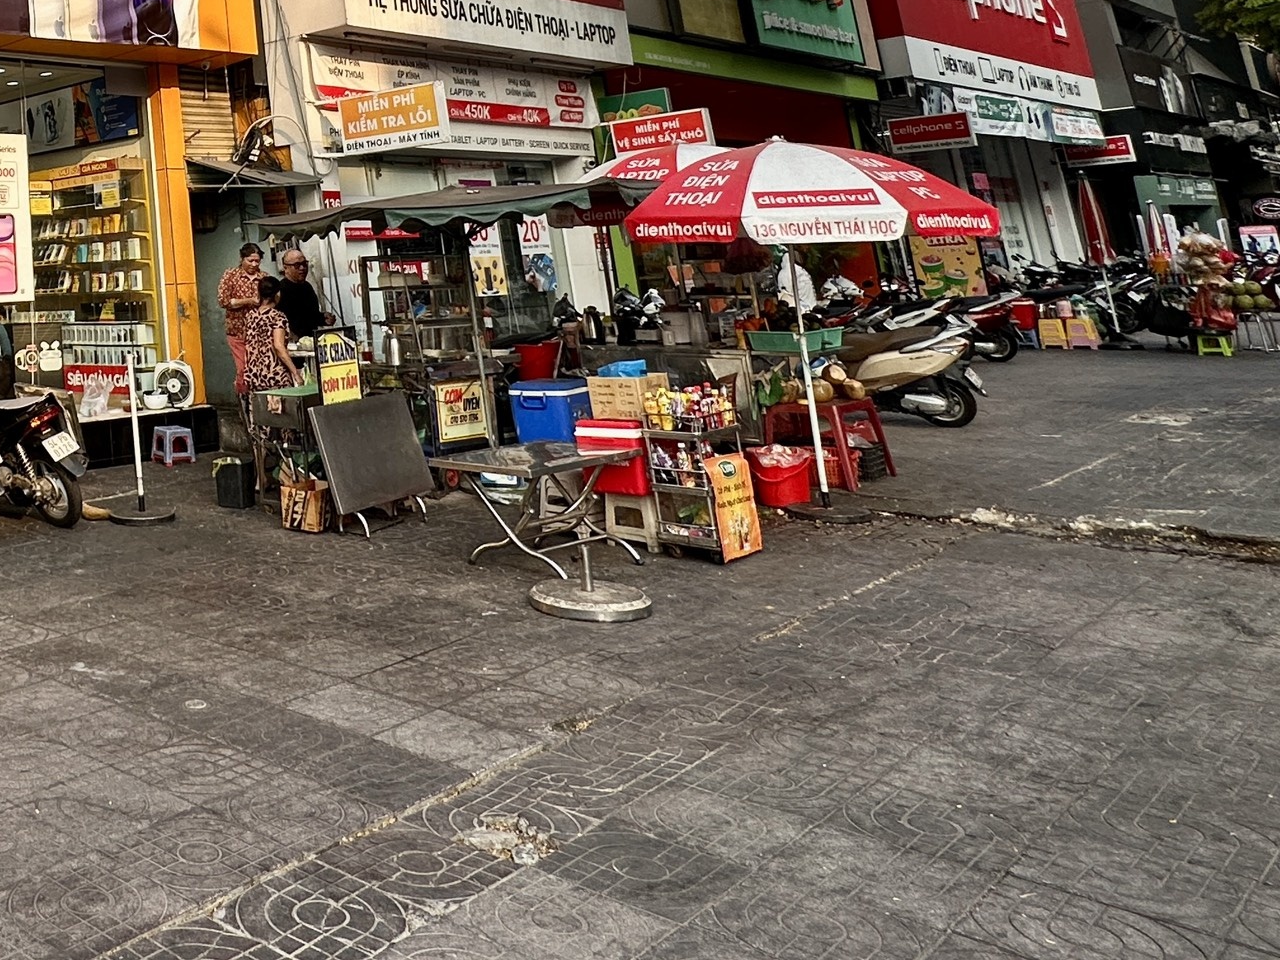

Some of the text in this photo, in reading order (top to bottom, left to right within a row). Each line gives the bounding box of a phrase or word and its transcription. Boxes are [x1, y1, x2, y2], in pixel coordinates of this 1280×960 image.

[469, 0, 504, 27] CHỮA
[506, 7, 534, 35] ĐIỆN
[535, 14, 570, 42] THOẠI
[575, 21, 616, 45] LAPTOP
[763, 11, 789, 29] juice
[799, 20, 838, 39] smoothie
[943, 55, 976, 78] ĐIỆN THOẠI
[995, 67, 1014, 83] LAPTOP
[450, 88, 473, 97] LAPTOP
[358, 93, 389, 114] MIỄN
[393, 89, 415, 107] PHÍ
[348, 105, 432, 135] KIỂM TRA LỖI
[464, 104, 490, 120] 450K
[522, 109, 541, 123] 40K
[635, 118, 680, 134] MIỄN PHÍ
[346, 130, 440, 151] ĐIỆN THOẠI MÁY TÍNH
[451, 136, 590, 151] TABLET LAPTOP BATTERY SCREEN QUICK SERVICE
[617, 127, 704, 149] VỆ SINH SẤY KHÔ
[627, 157, 661, 169] SỬA
[699, 159, 740, 172] SỬA
[682, 173, 731, 190] ĐIỆN
[324, 198, 341, 209] 136
[665, 191, 723, 207] THOẠI
[758, 191, 875, 206] dienthoaivui
[753, 217, 898, 238] 136 NGUYỄN THÁI HỌC
[916, 214, 992, 229] dienthoaivui
[635, 222, 732, 238] dienthoaivui
[67, 369, 88, 386] SIÊU
[323, 369, 358, 393] CƠM TẤM
